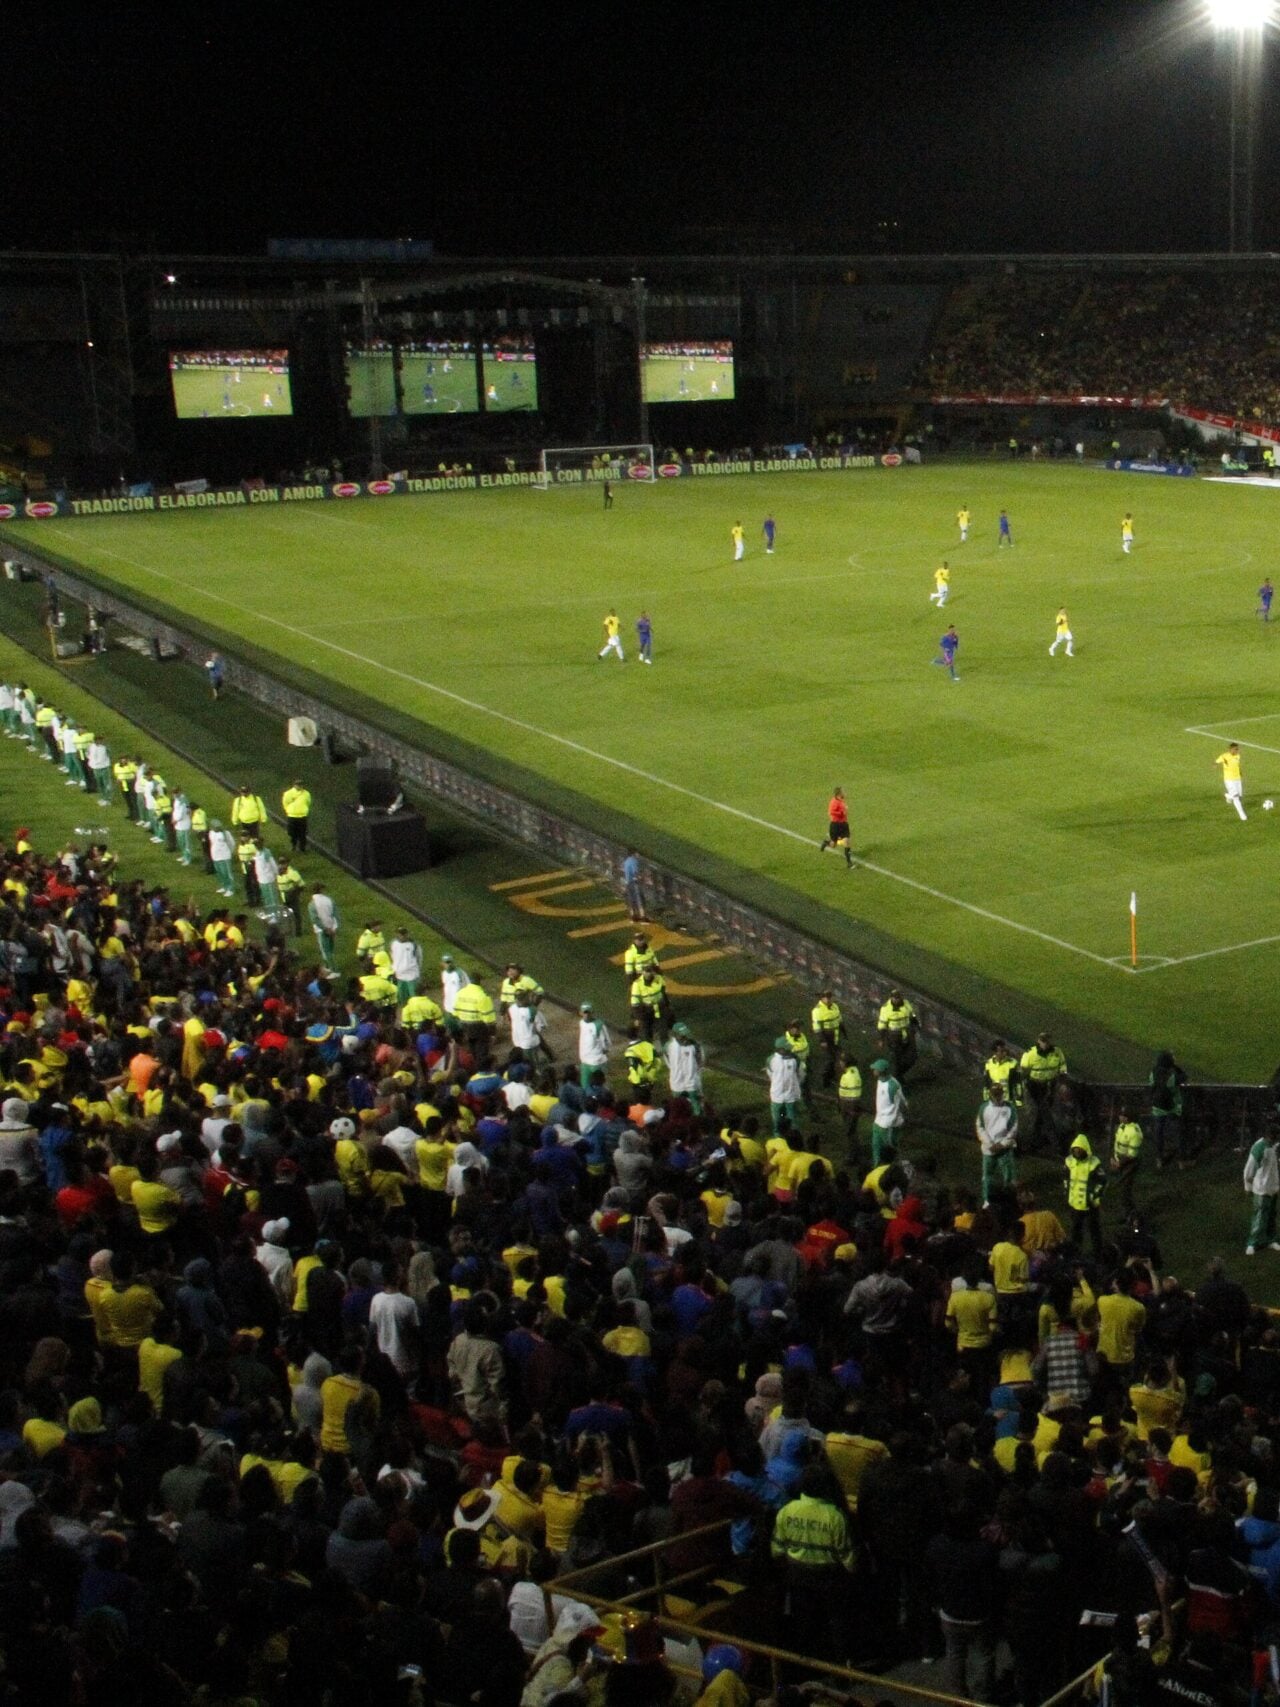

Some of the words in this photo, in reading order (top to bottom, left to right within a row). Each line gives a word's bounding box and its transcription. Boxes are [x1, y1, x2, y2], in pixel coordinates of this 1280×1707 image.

[691, 461, 750, 475] TRADICION
[754, 458, 818, 473] ELABORADA
[820, 457, 842, 469] CON
[844, 455, 875, 468] AMOR
[407, 475, 476, 492] TRADICION
[480, 471, 553, 487] ELABORADA
[557, 469, 582, 482] CON
[585, 467, 621, 481] AMOR
[72, 497, 154, 514] TRADICION
[159, 490, 246, 509] ELABORADA
[249, 488, 279, 503] CON
[283, 485, 324, 501] AMOR
